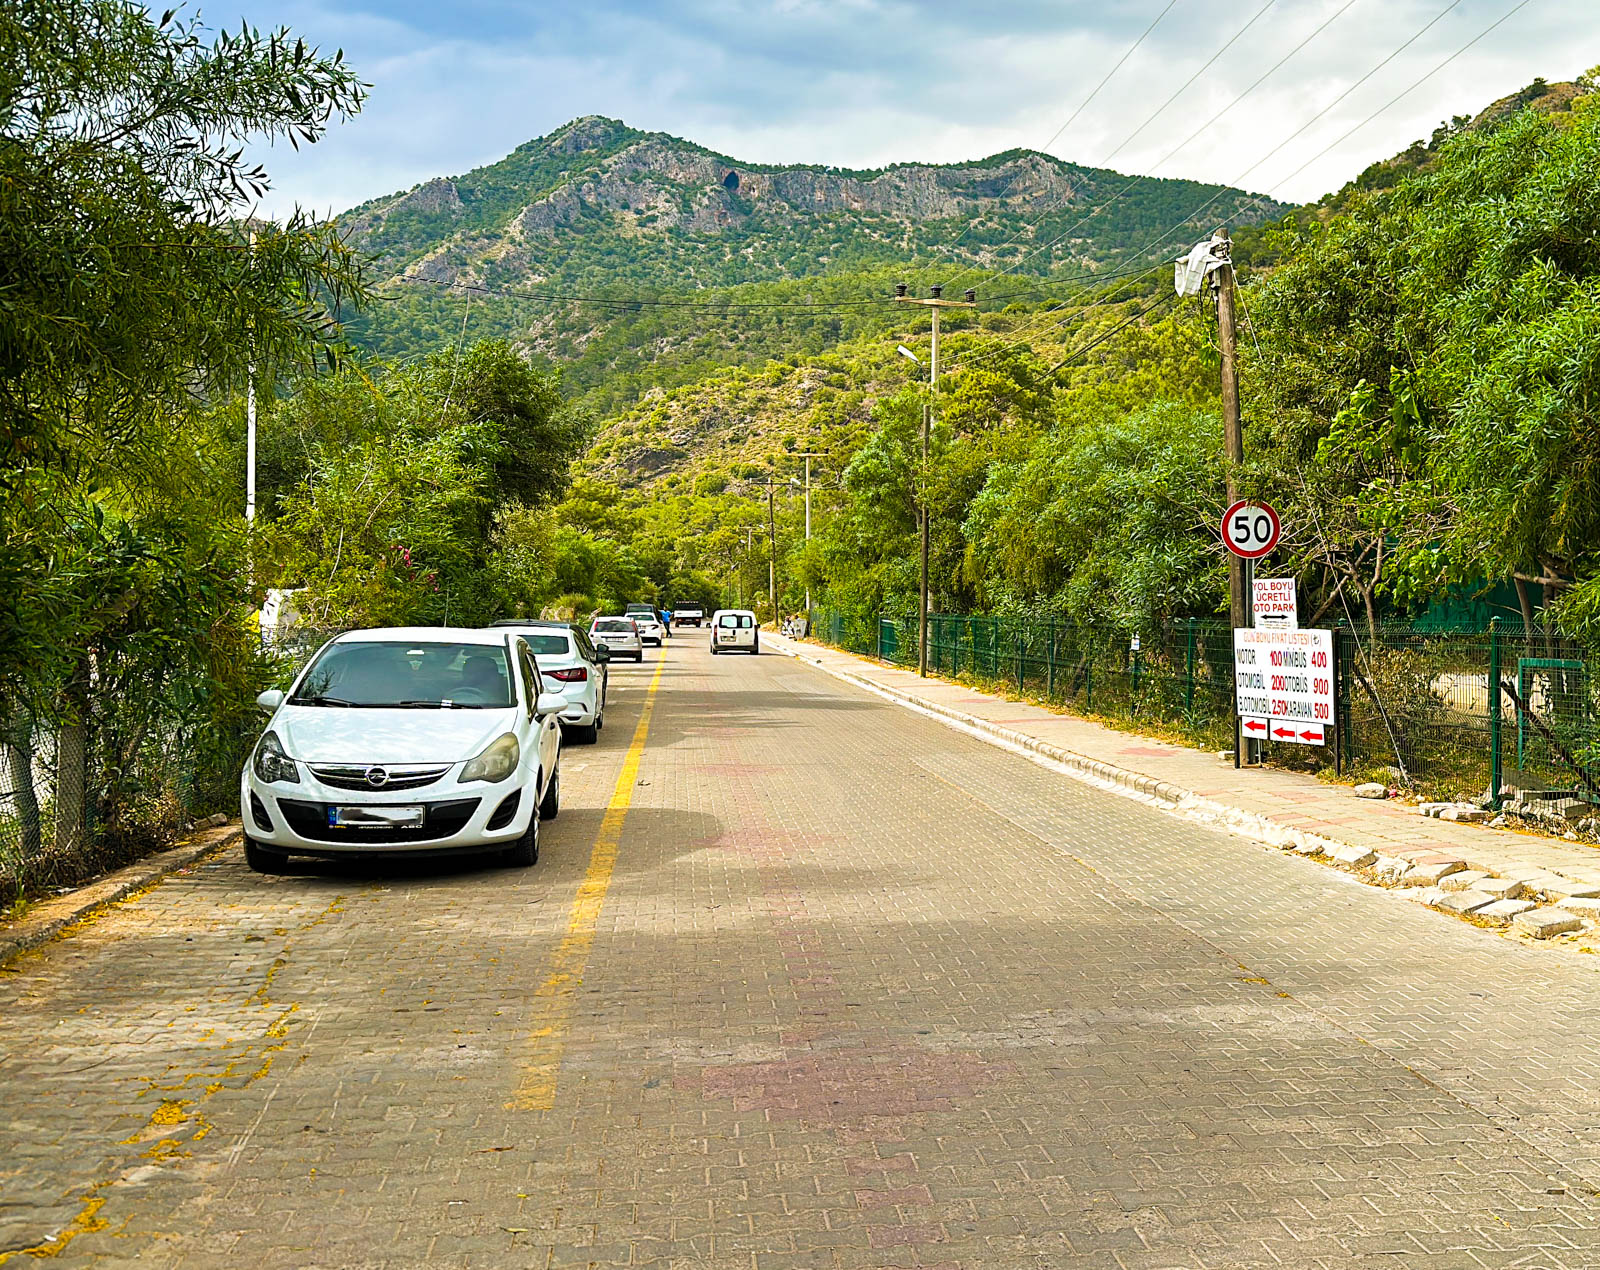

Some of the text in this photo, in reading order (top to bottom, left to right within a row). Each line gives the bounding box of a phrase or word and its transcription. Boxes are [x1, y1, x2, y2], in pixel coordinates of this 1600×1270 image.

[1234, 515, 1271, 544] 50
[1252, 582, 1294, 591] YOL BOYU
[1256, 590, 1291, 602] ÜCRETLİ
[1253, 603, 1295, 612] OTO PARK
[1236, 648, 1327, 668] MOTOR 100 MİNİBÜS 400
[1238, 670, 1329, 696] OTOMOBİL 200 OTOBÜS 900
[1272, 699, 1286, 715] 250
[1286, 701, 1312, 718] KARAVAN
[1314, 703, 1329, 720] 500
